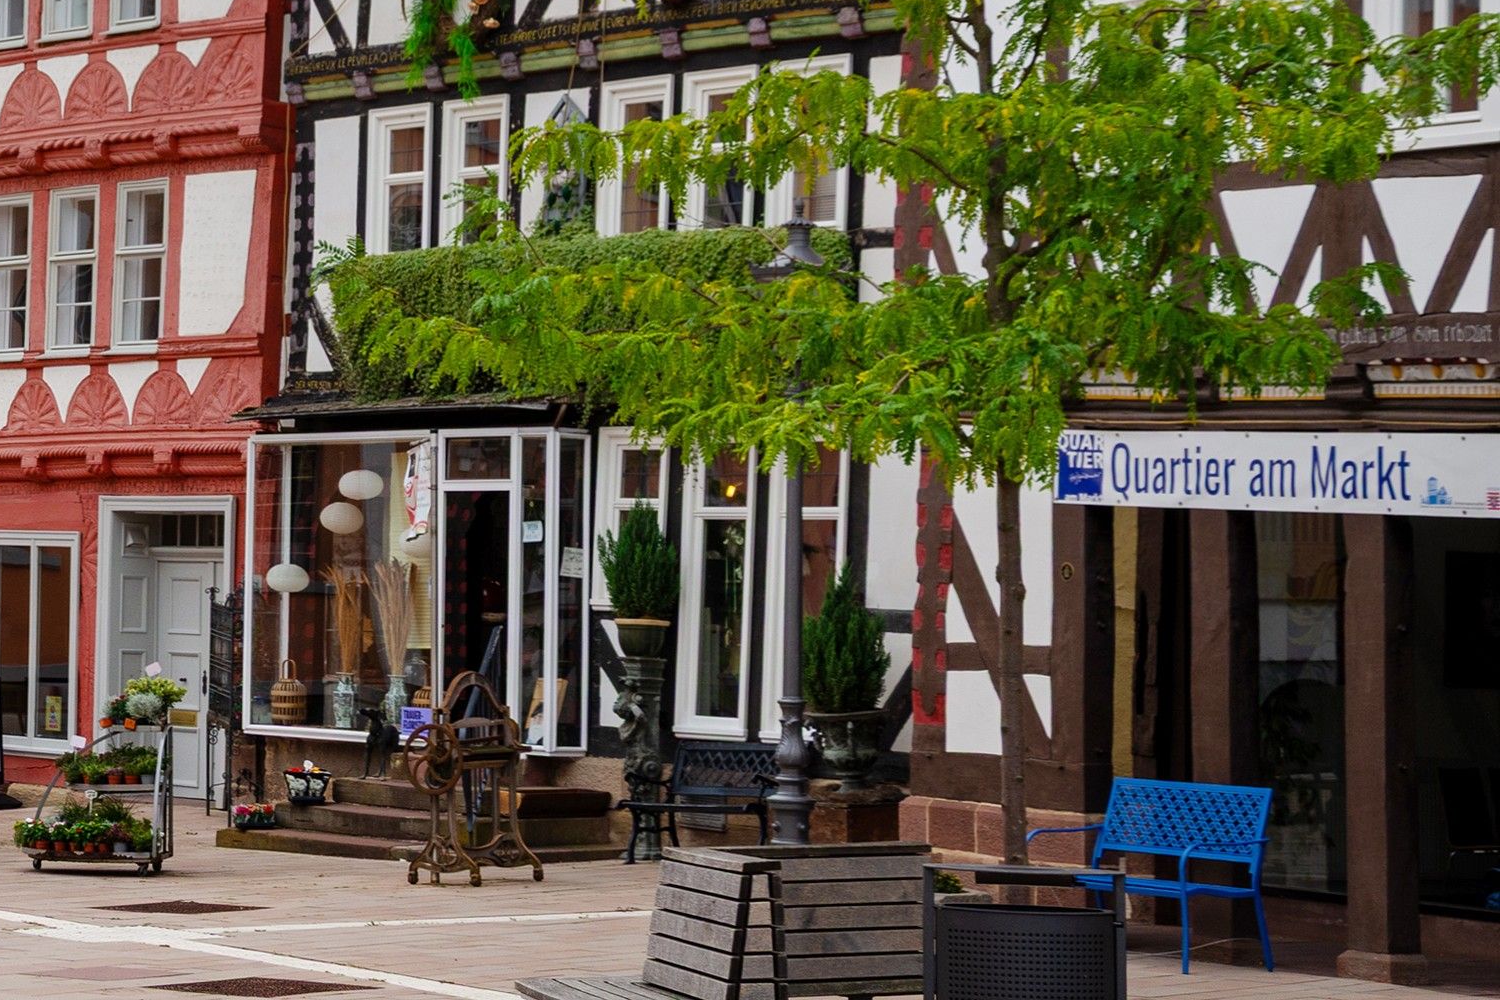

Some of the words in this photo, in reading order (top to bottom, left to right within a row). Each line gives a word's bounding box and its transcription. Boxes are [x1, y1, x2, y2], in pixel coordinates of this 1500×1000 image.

[1111, 442, 1236, 500] Quartier
[1249, 455, 1296, 498] am
[1311, 445, 1412, 501] Markt
